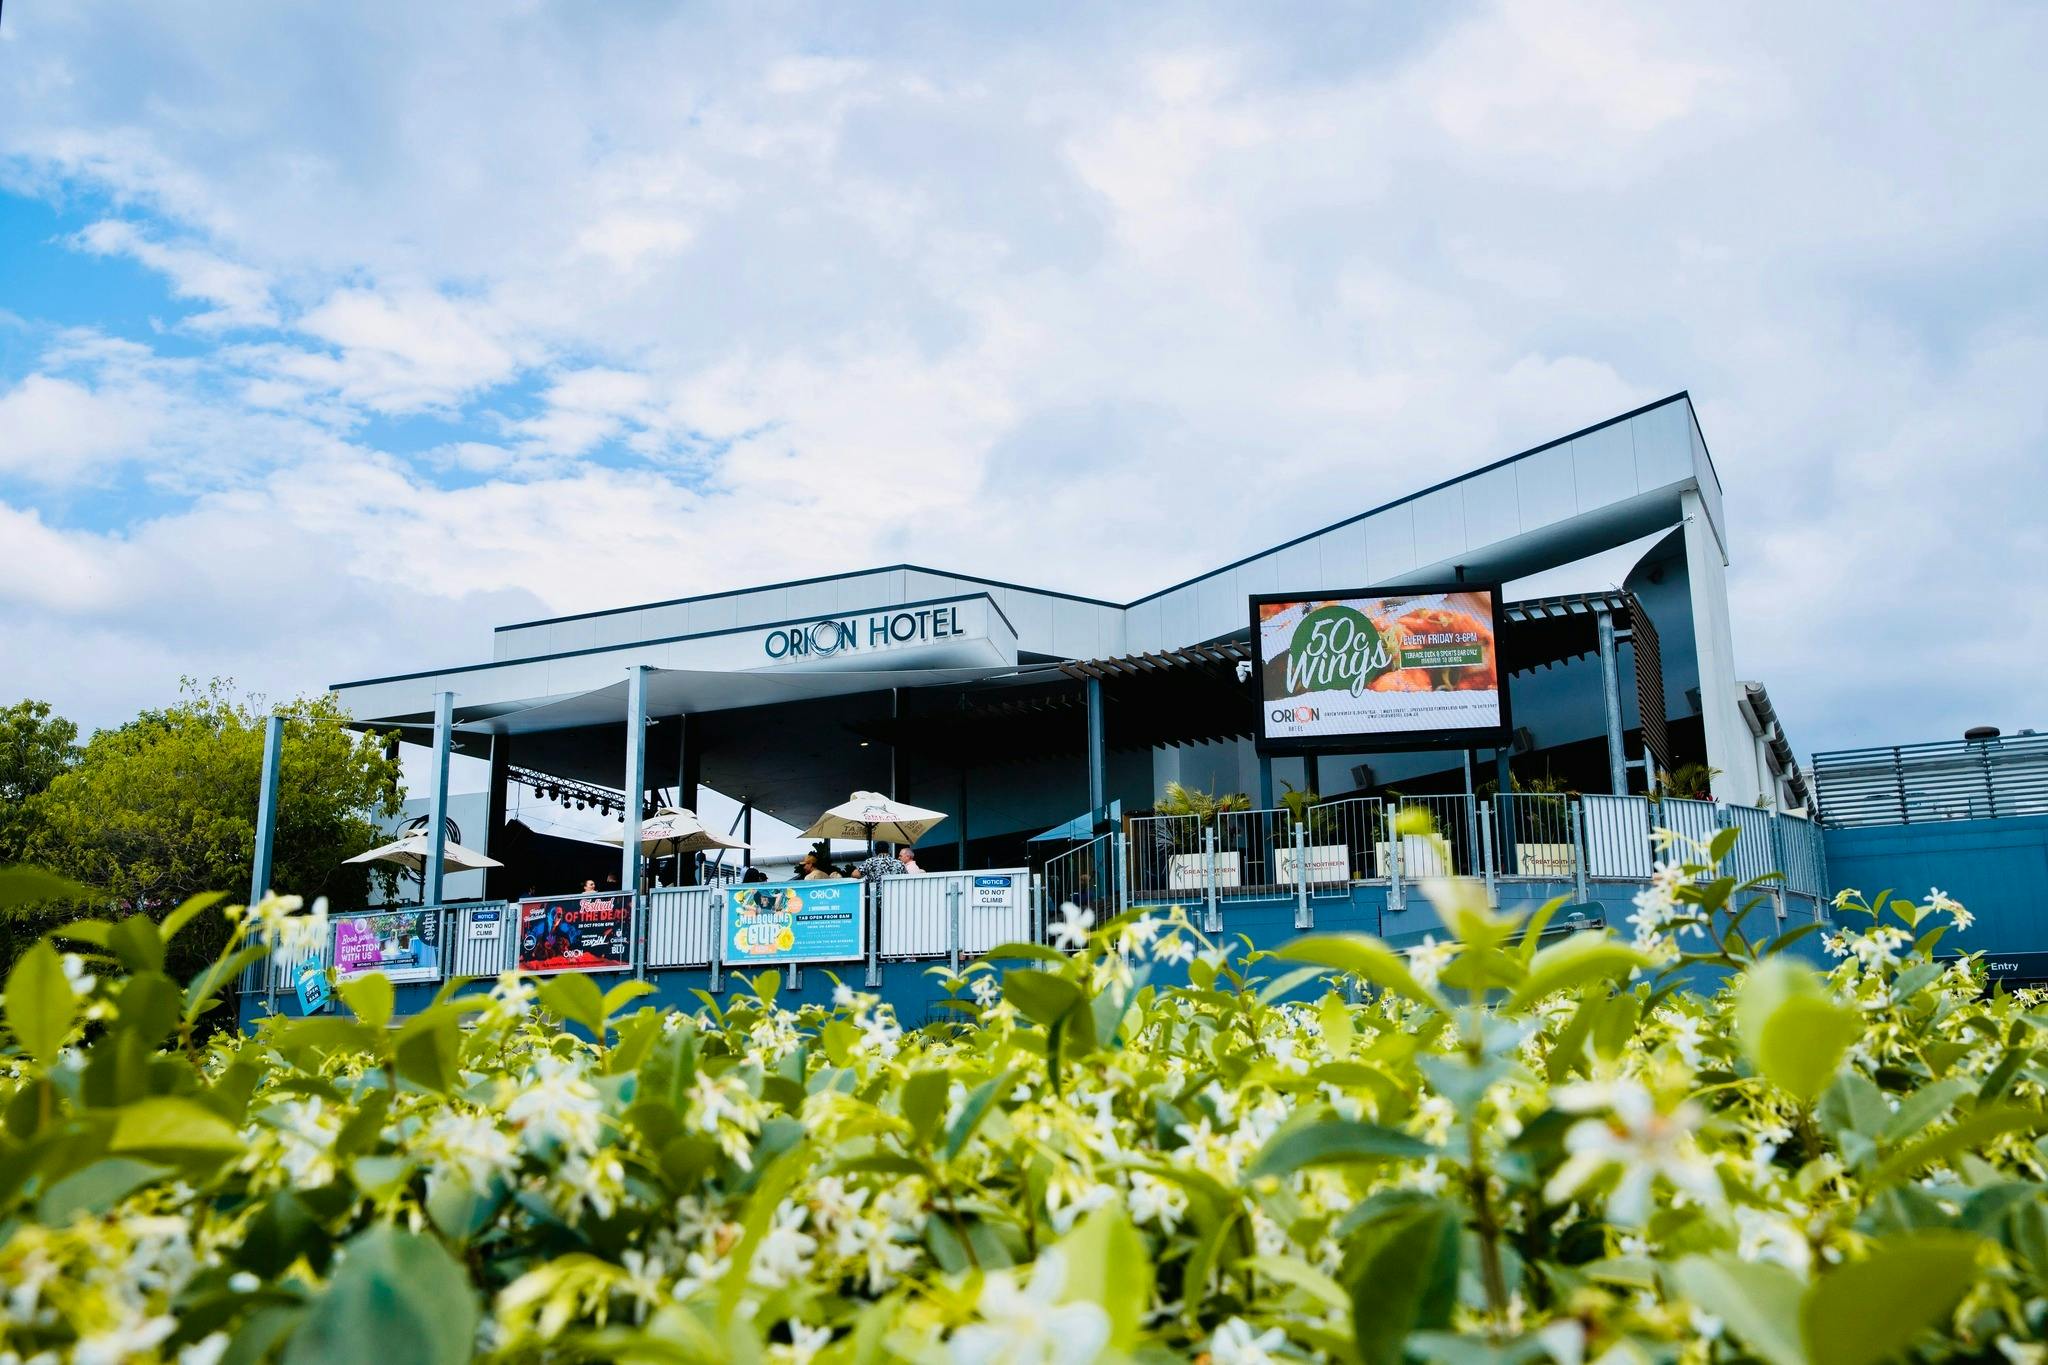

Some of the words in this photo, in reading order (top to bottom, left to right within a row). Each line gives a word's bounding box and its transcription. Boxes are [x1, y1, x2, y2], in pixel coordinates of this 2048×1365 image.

[765, 620, 858, 658] ORION
[869, 606, 963, 646] HOTEL
[1306, 616, 1369, 656] 50c
[1403, 634, 1426, 645] EVERY
[1427, 632, 1454, 644] FRIDAY
[1455, 631, 1478, 643] 3-6PM
[1286, 639, 1392, 698] Wings
[1271, 706, 1320, 724] ORION
[810, 888, 840, 900] ORION
[580, 897, 615, 913] Festival
[565, 911, 578, 923] OF
[580, 910, 598, 922] THE
[342, 934, 357, 945] Book
[748, 924, 780, 946] CUP
[341, 943, 380, 953] FUNCTION
[563, 949, 583, 958] ORION
[341, 952, 360, 962] WITH
[362, 951, 373, 960] US
[1991, 962, 2019, 971] Entry
